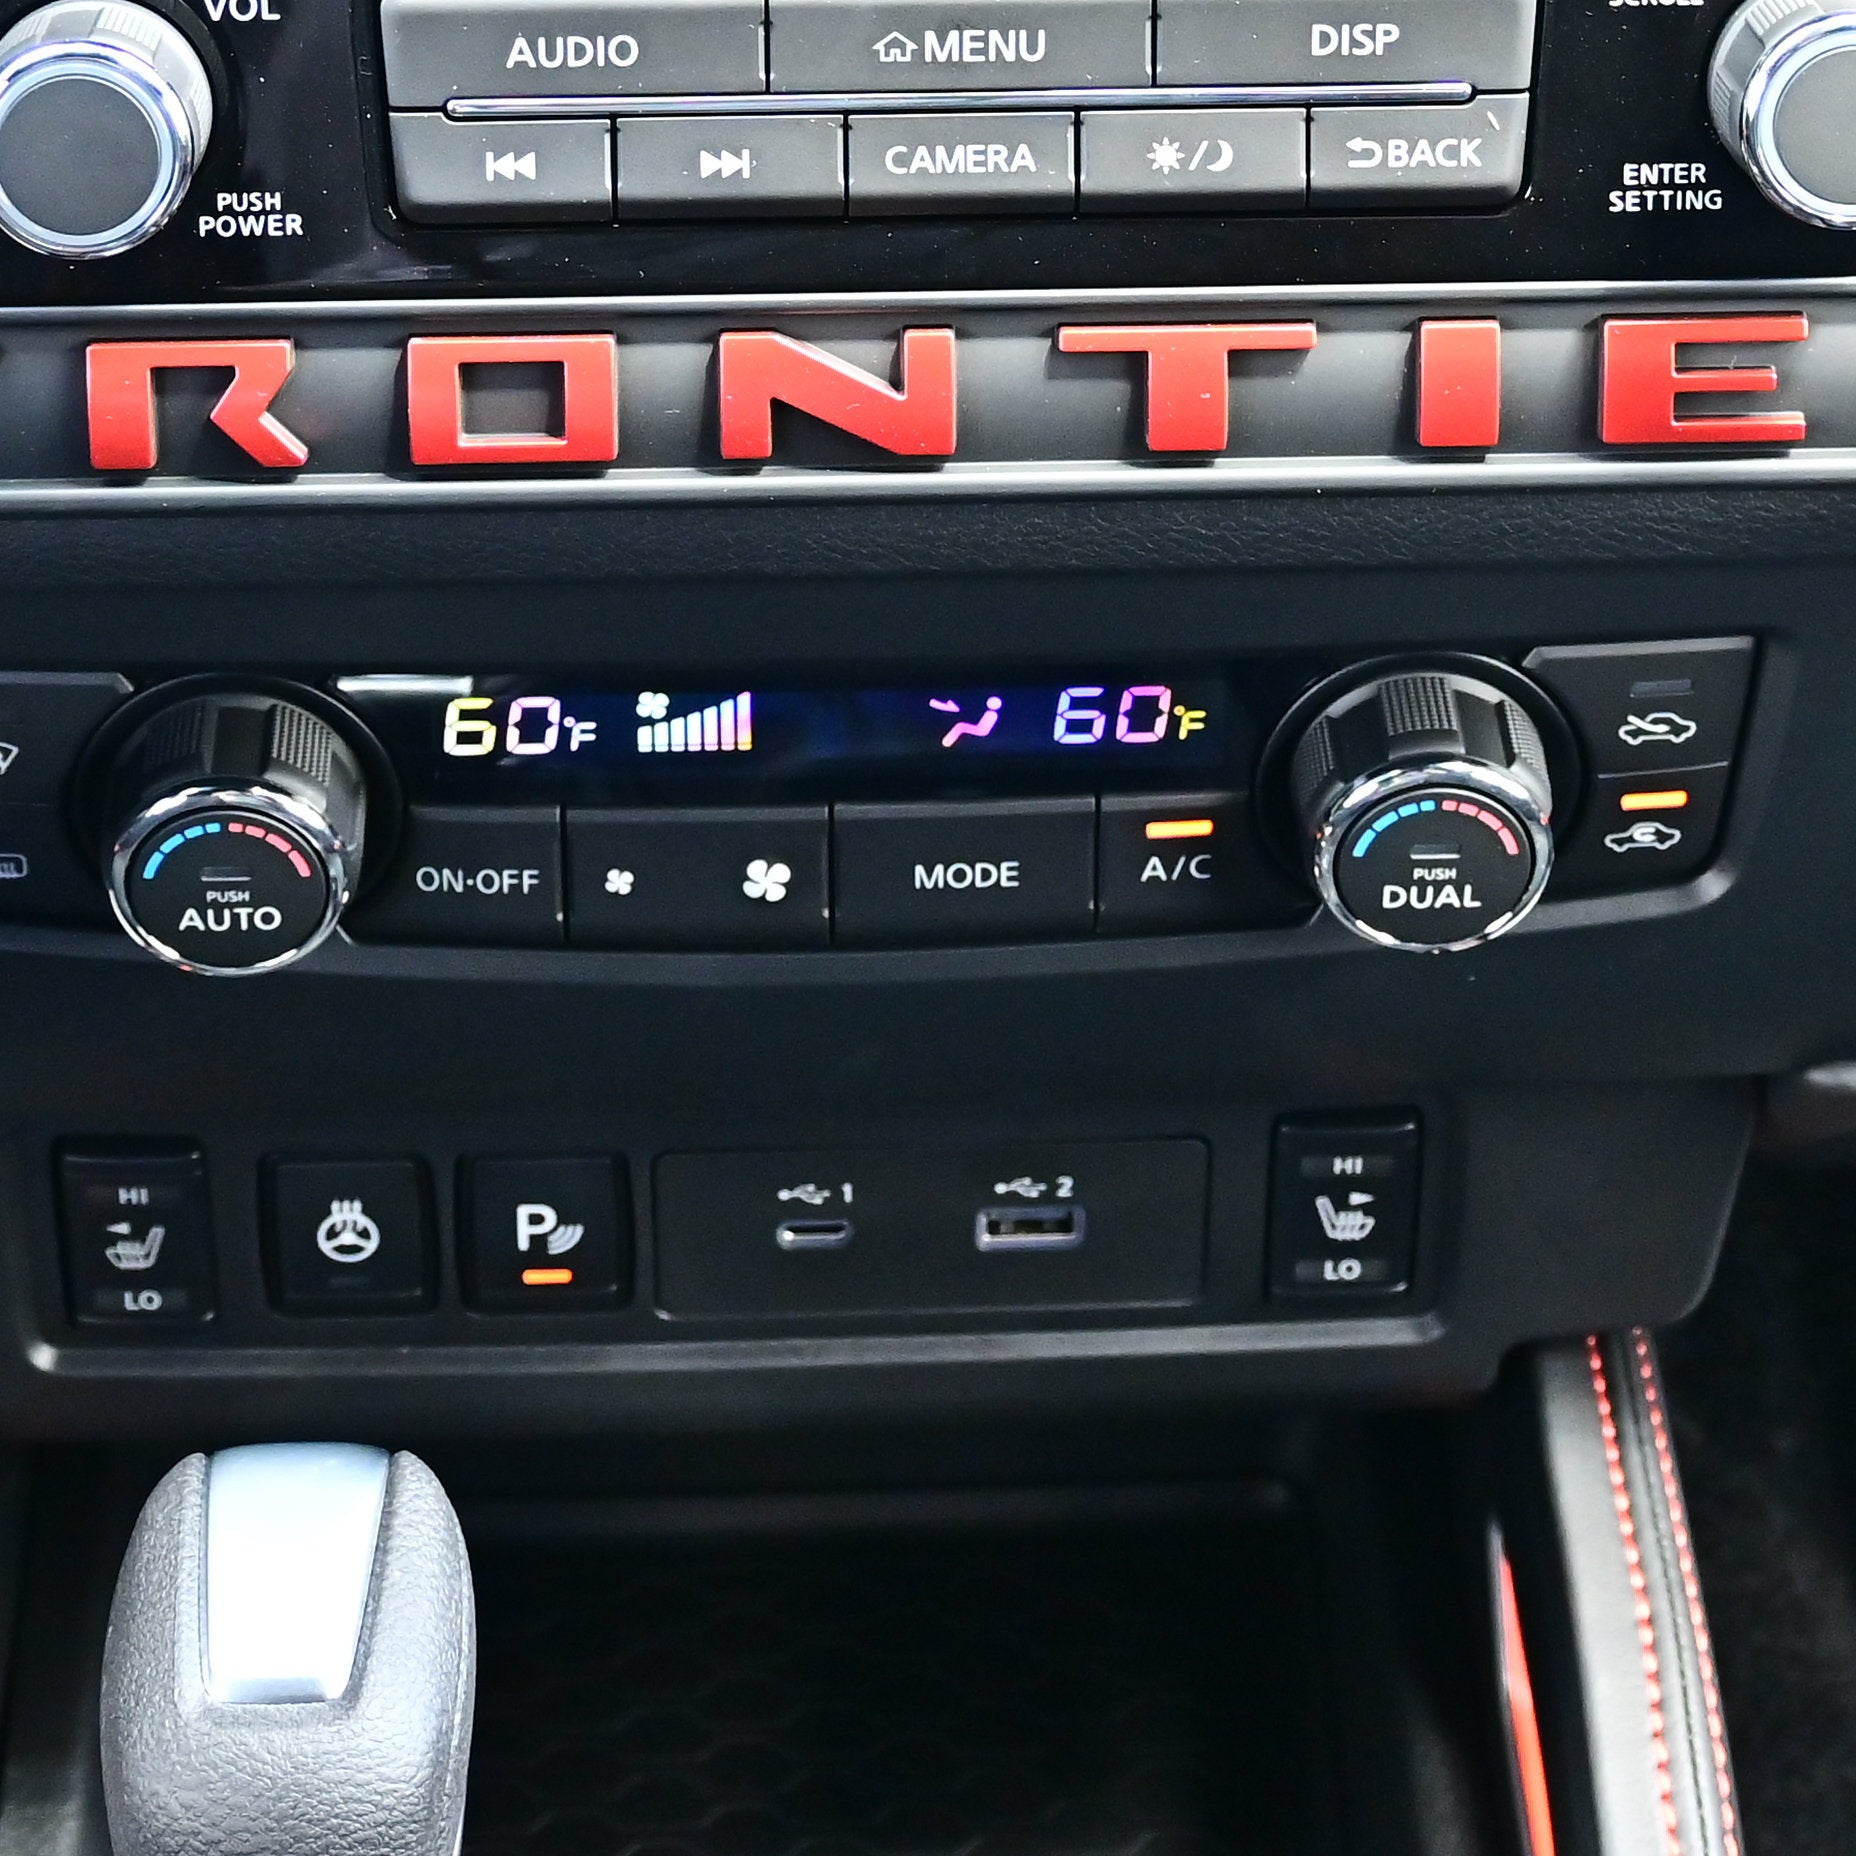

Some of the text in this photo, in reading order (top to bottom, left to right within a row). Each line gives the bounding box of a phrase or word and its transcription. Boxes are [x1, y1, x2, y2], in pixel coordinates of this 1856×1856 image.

[505, 34, 639, 69] AUDIO
[924, 29, 1046, 63] MENU
[1311, 23, 1400, 57] DISP
[884, 143, 1038, 175] CAMERA
[1387, 137, 1483, 168] BACK
[1623, 162, 1707, 186] ENTER
[216, 191, 282, 212] PUSH
[1608, 189, 1723, 213] SETTING
[198, 213, 304, 238] POWER
[914, 860, 1020, 890] MODE
[1140, 854, 1211, 883] A/C
[1412, 867, 1457, 881] PUSH
[205, 889, 251, 903] PUSH
[1382, 883, 1482, 910] DUAL
[178, 906, 282, 932] AUTO
[1332, 1156, 1364, 1175] HI
[118, 1187, 150, 1205] HI
[1055, 1175, 1074, 1198] 2
[1323, 1258, 1363, 1281] LO
[123, 1289, 163, 1311] LO
